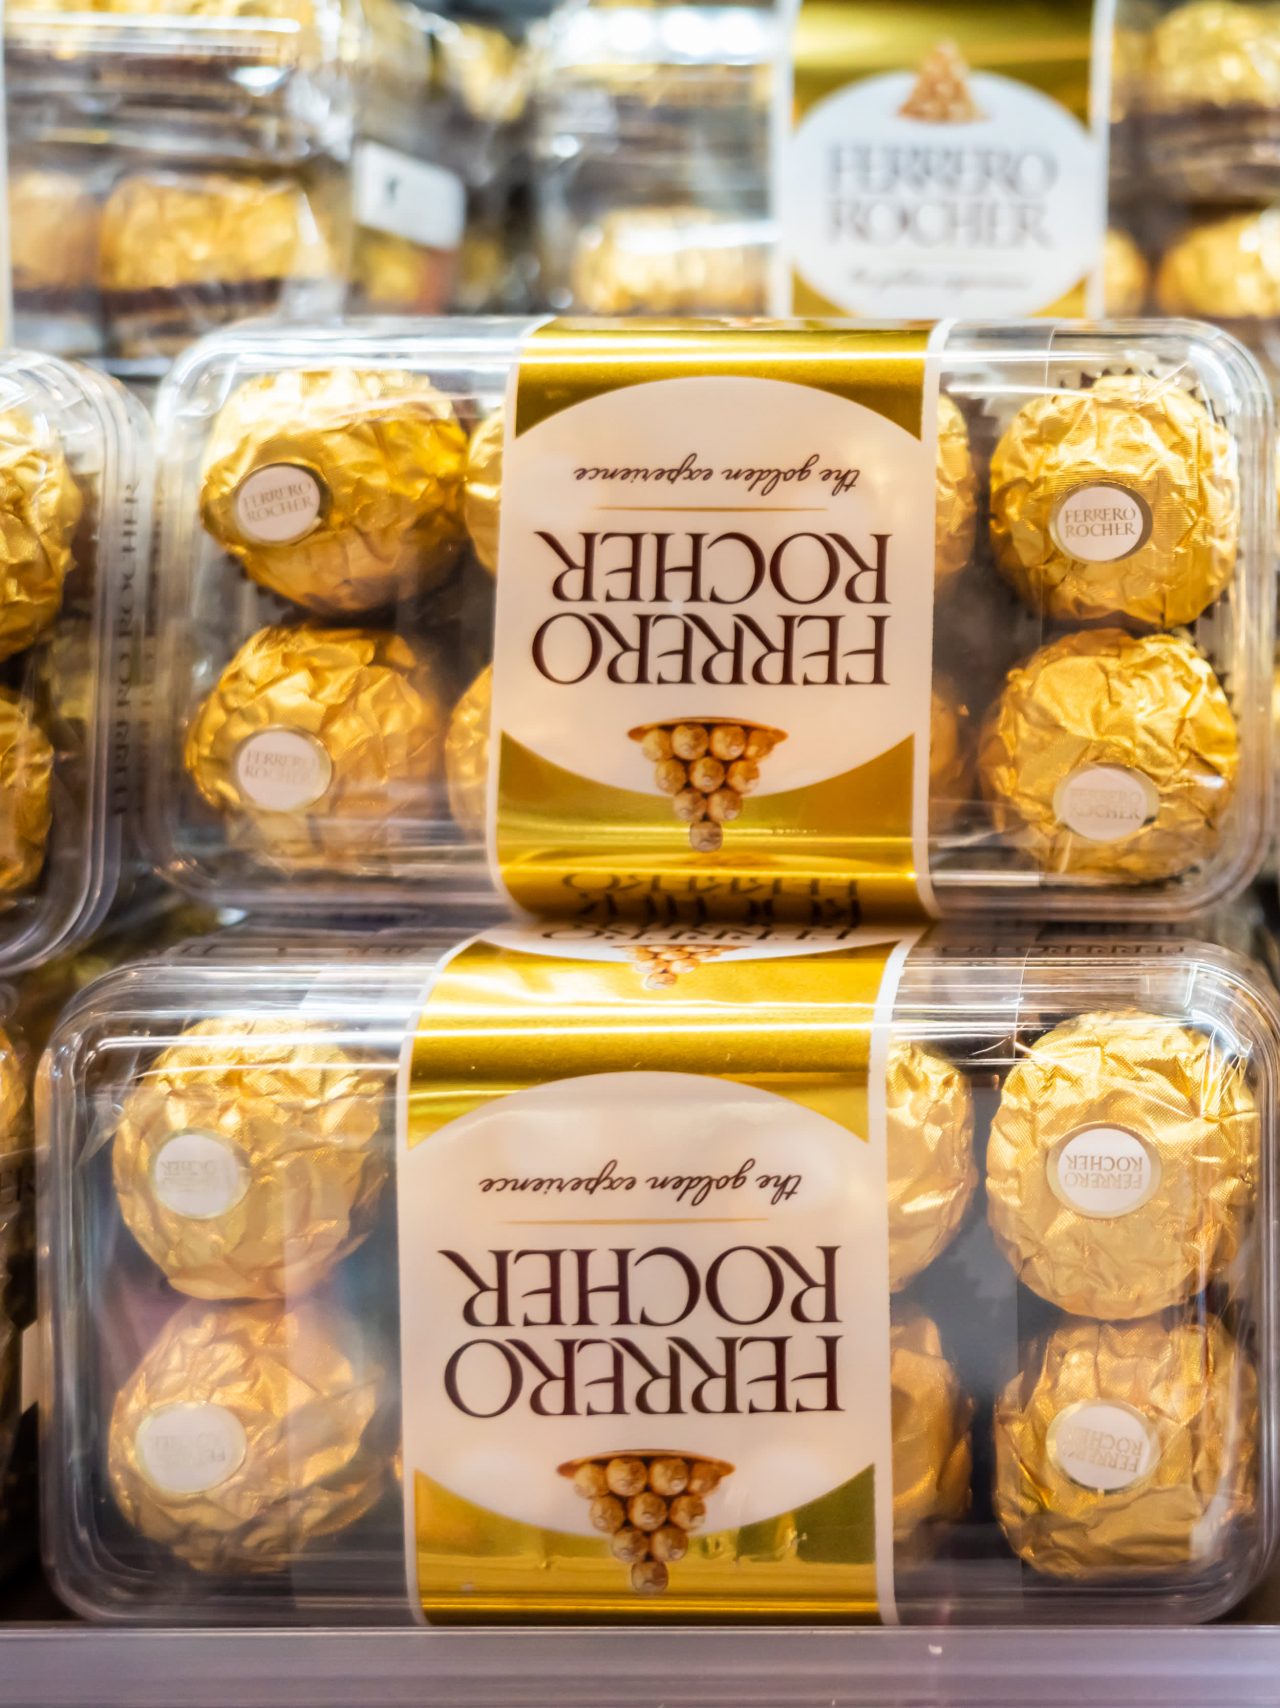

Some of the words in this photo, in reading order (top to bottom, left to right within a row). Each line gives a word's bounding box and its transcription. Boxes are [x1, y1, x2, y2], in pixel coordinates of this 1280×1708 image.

[825, 142, 1060, 196] FERRERO
[826, 199, 1057, 250] ROCHER
[573, 452, 713, 485] experience
[721, 453, 820, 496] golden
[819, 469, 860, 496] the
[243, 482, 312, 509] FERRERO
[246, 496, 313, 522] ROCHER
[1064, 507, 1137, 523] FERRERO
[1065, 521, 1136, 539] ROCHER
[534, 531, 893, 605] ROCHER
[531, 611, 891, 687] FERRERO
[479, 1159, 637, 1195] experience
[1066, 1155, 1142, 1172] ROCHER
[646, 1157, 756, 1206] golden
[755, 1173, 802, 1206] the
[1065, 1173, 1142, 1190] FERRERO
[437, 1245, 844, 1327] ROCHER
[443, 1334, 845, 1420] FERRERO
